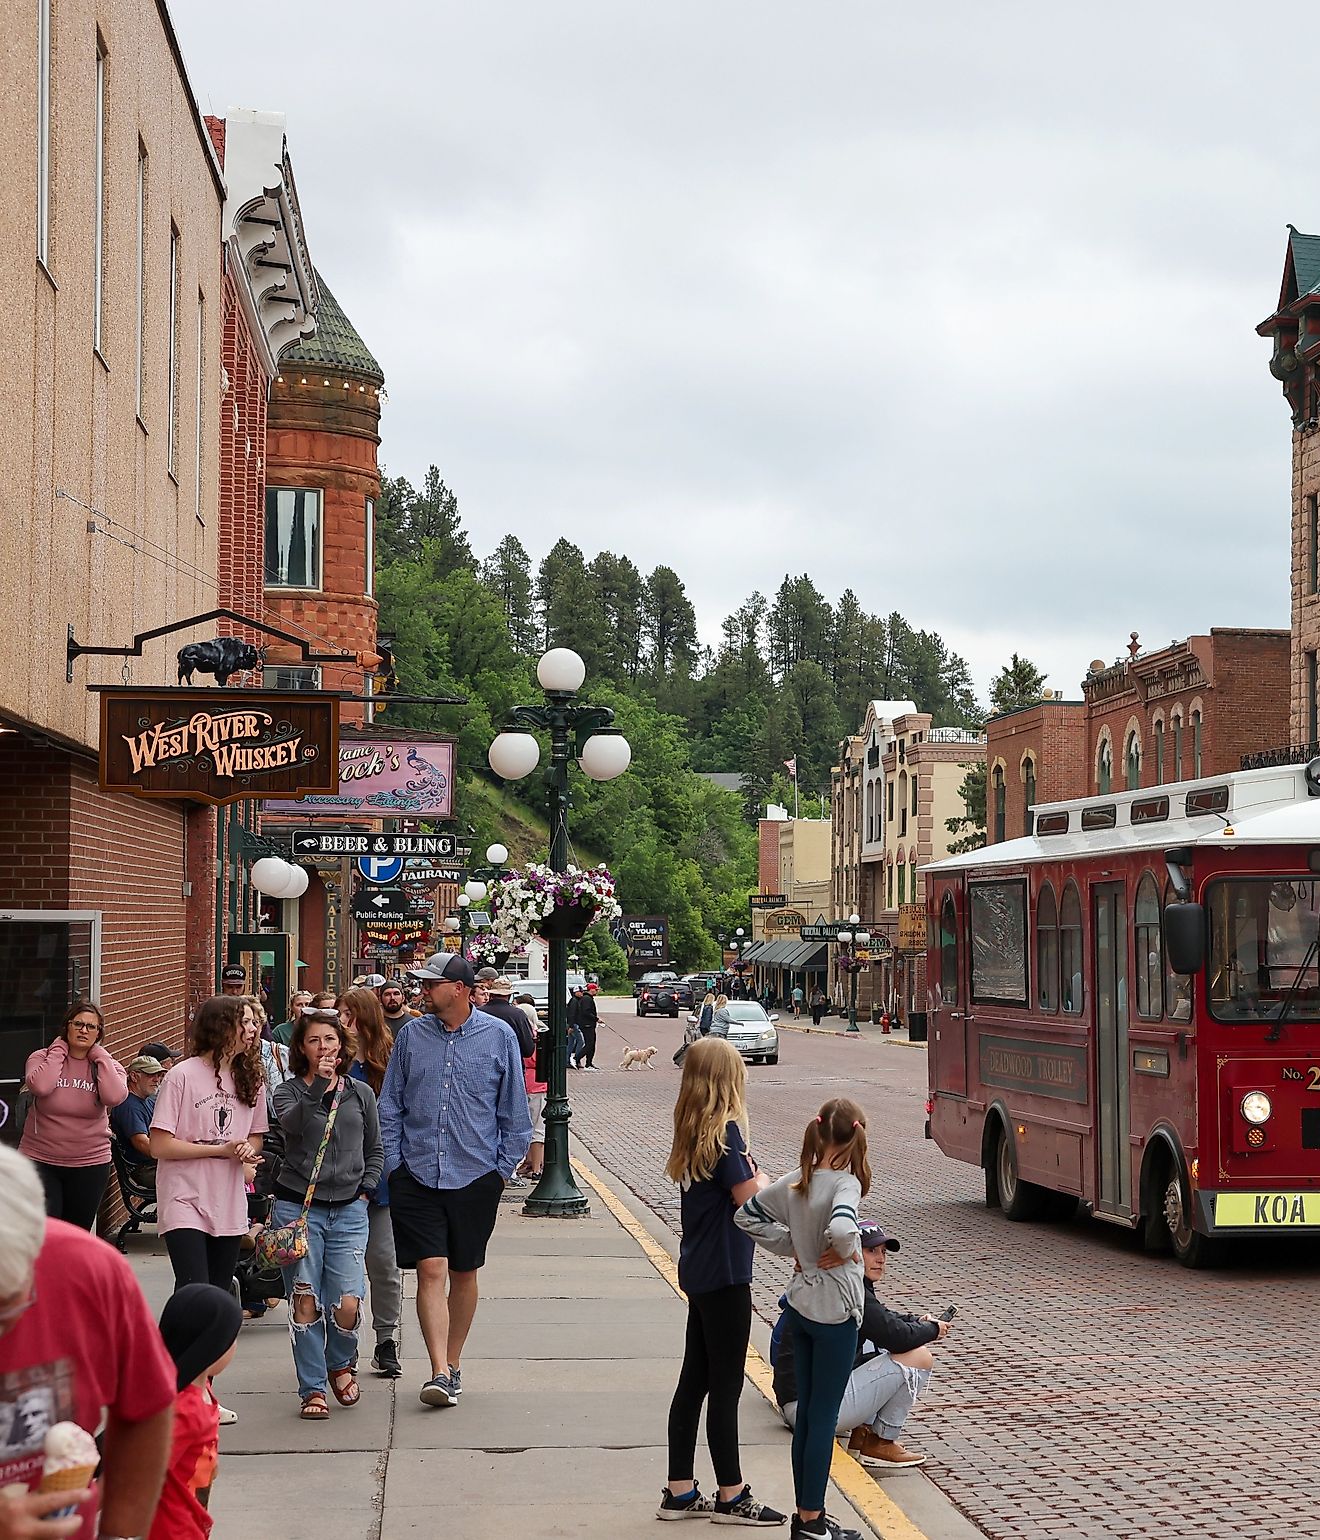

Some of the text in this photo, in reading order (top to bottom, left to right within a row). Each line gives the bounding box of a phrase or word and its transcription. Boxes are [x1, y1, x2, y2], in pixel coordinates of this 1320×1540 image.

[319, 835, 452, 854] BEER & BLING
[370, 856, 396, 878] P
[355, 910, 404, 921] Public Parking
[777, 915, 801, 926] GEM
[989, 1050, 1074, 1085] DEADWOOD TROLLEY
[1282, 1067, 1304, 1080] No.
[1254, 1194, 1306, 1224] KOA
